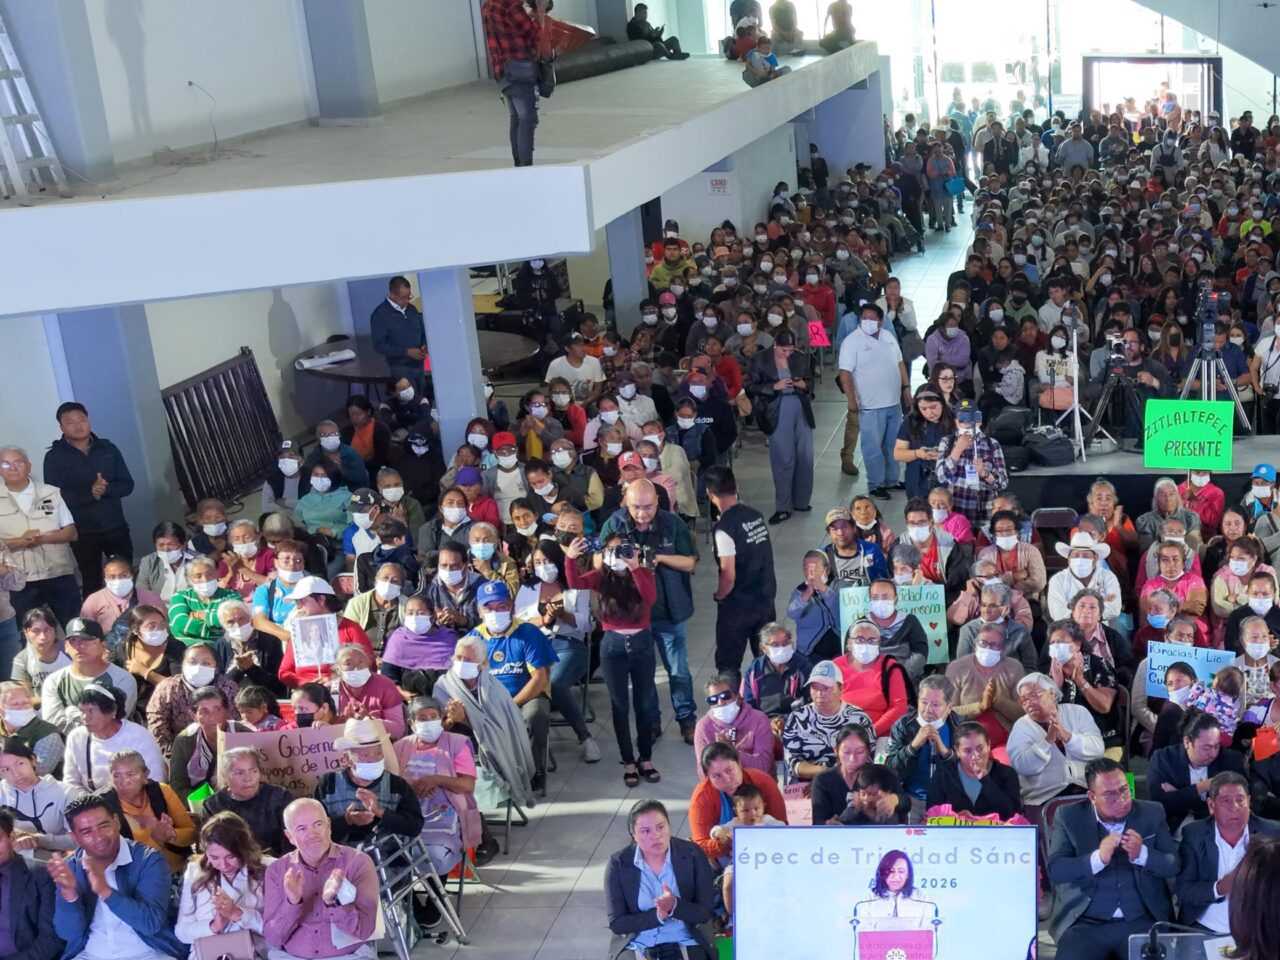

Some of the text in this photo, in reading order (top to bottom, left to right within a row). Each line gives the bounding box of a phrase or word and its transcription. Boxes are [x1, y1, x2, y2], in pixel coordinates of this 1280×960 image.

[1145, 410, 1228, 441] ZITLALTEPEC
[1164, 440, 1222, 457] PRESENTE
[301, 759, 318, 774] de
[811, 846, 840, 866] de
[851, 846, 958, 867] Tridad
[970, 844, 1031, 866] Sánc
[920, 878, 958, 889] 2026
